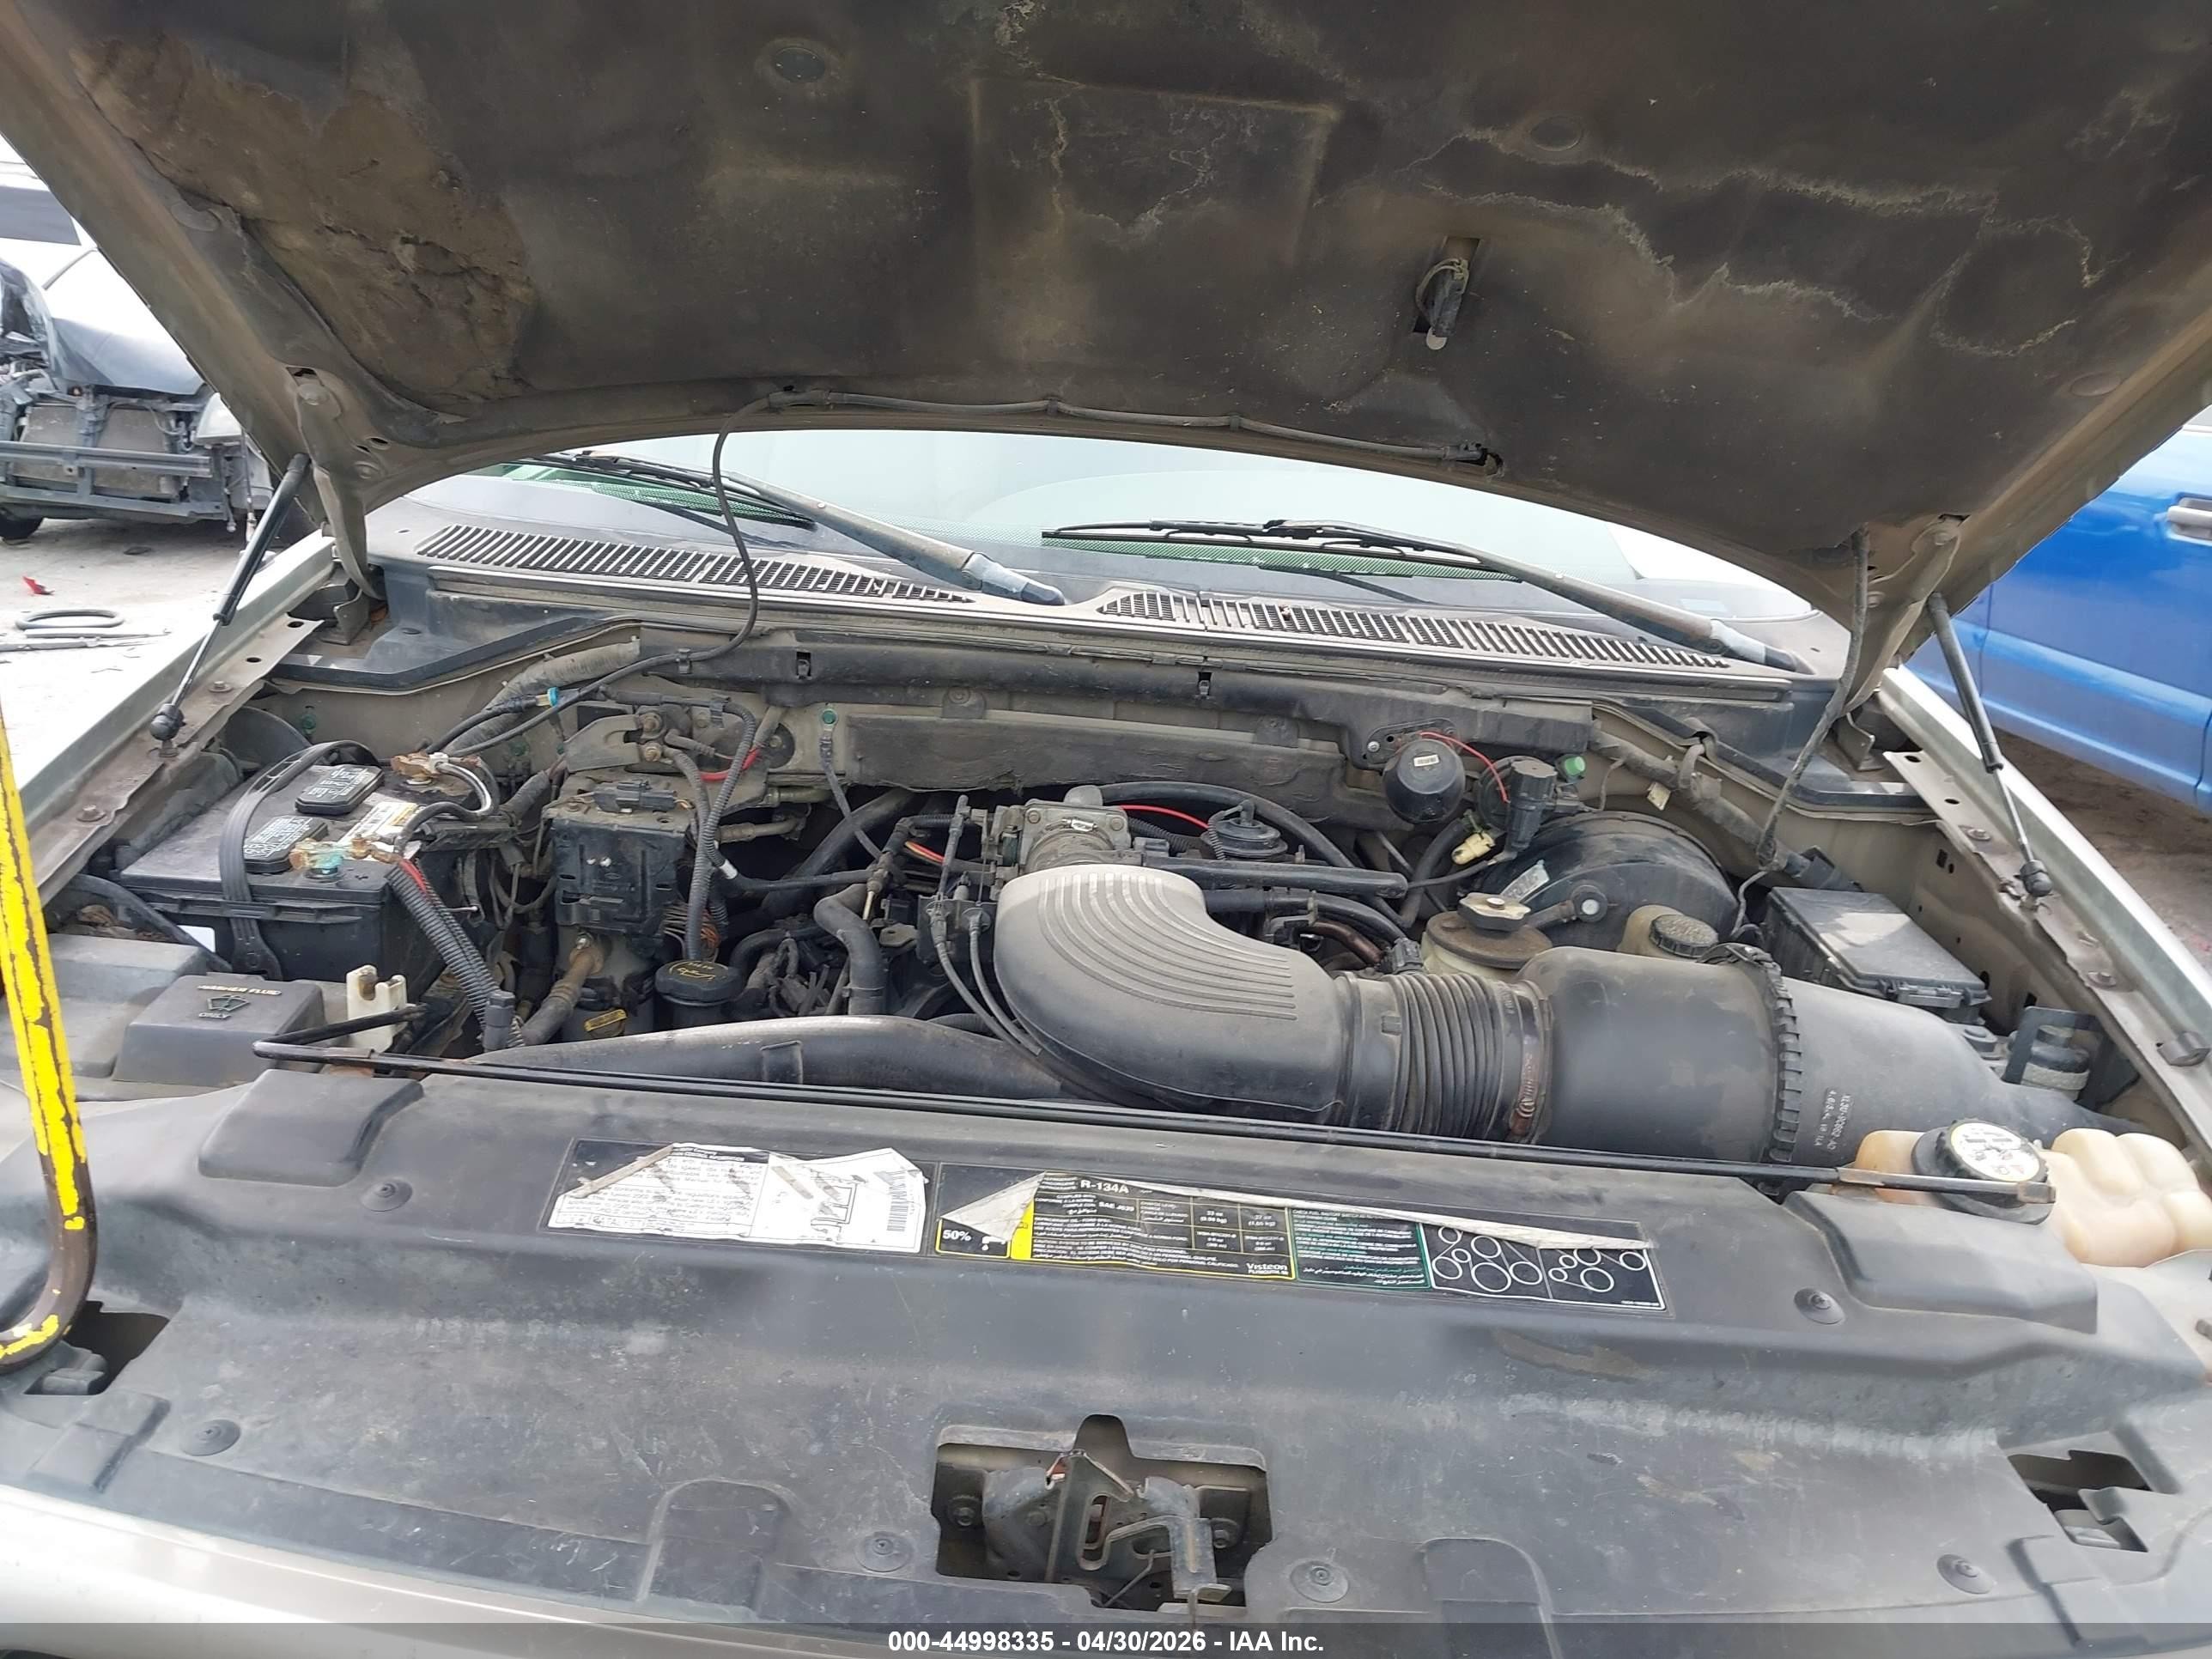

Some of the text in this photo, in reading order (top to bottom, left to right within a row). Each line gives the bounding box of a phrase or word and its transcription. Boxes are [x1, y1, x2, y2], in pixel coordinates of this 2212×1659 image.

[1080, 1180, 1129, 1194] R-134A
[942, 1229, 972, 1242] 50%
[1246, 1262, 1288, 1271] Visteon
